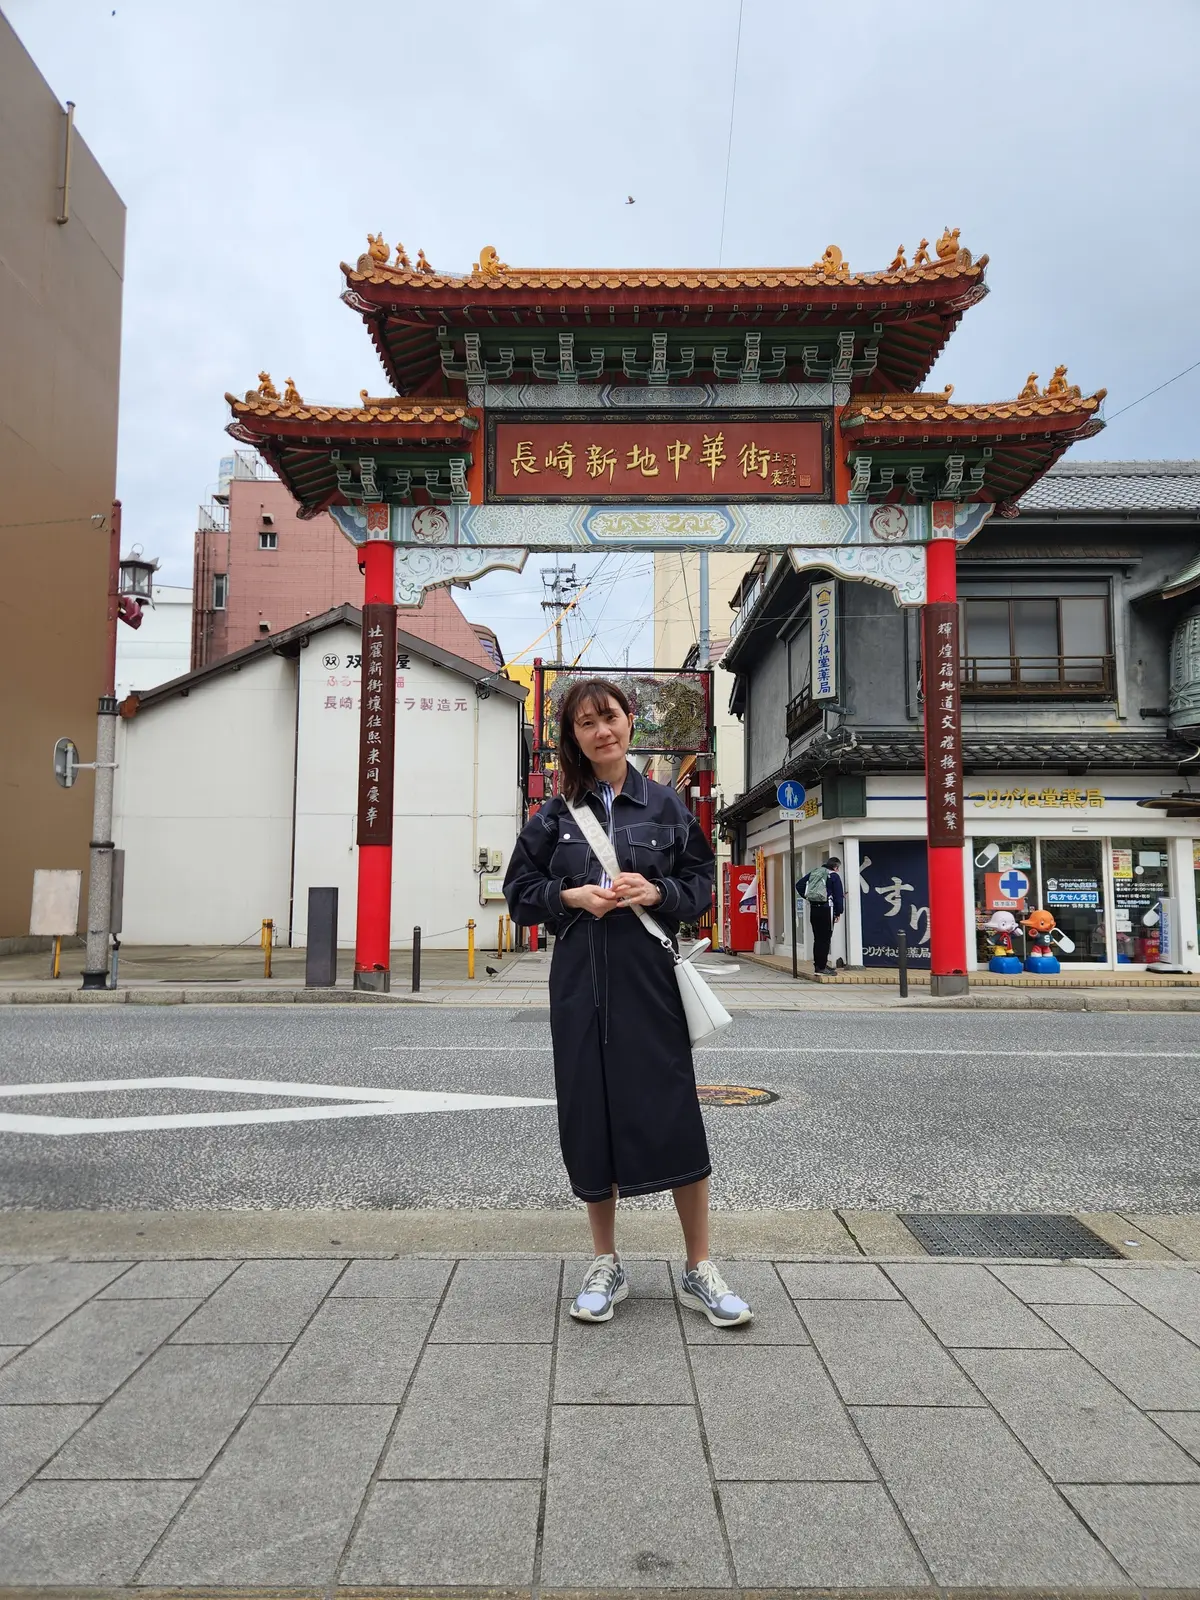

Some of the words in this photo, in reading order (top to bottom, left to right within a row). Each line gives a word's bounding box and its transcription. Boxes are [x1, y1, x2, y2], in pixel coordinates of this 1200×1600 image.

[510, 432, 771, 483] 長崎新地中華街
[818, 608, 831, 694] つりがね堂薬局
[346, 655, 411, 670] 双屋
[324, 696, 468, 711] 長崎ラ製造元
[968, 787, 1105, 808] つりがね堂薬局
[781, 811, 804, 819] 11-21
[1050, 893, 1096, 901] 処方せん受付
[862, 946, 932, 959] つりがね薬局
